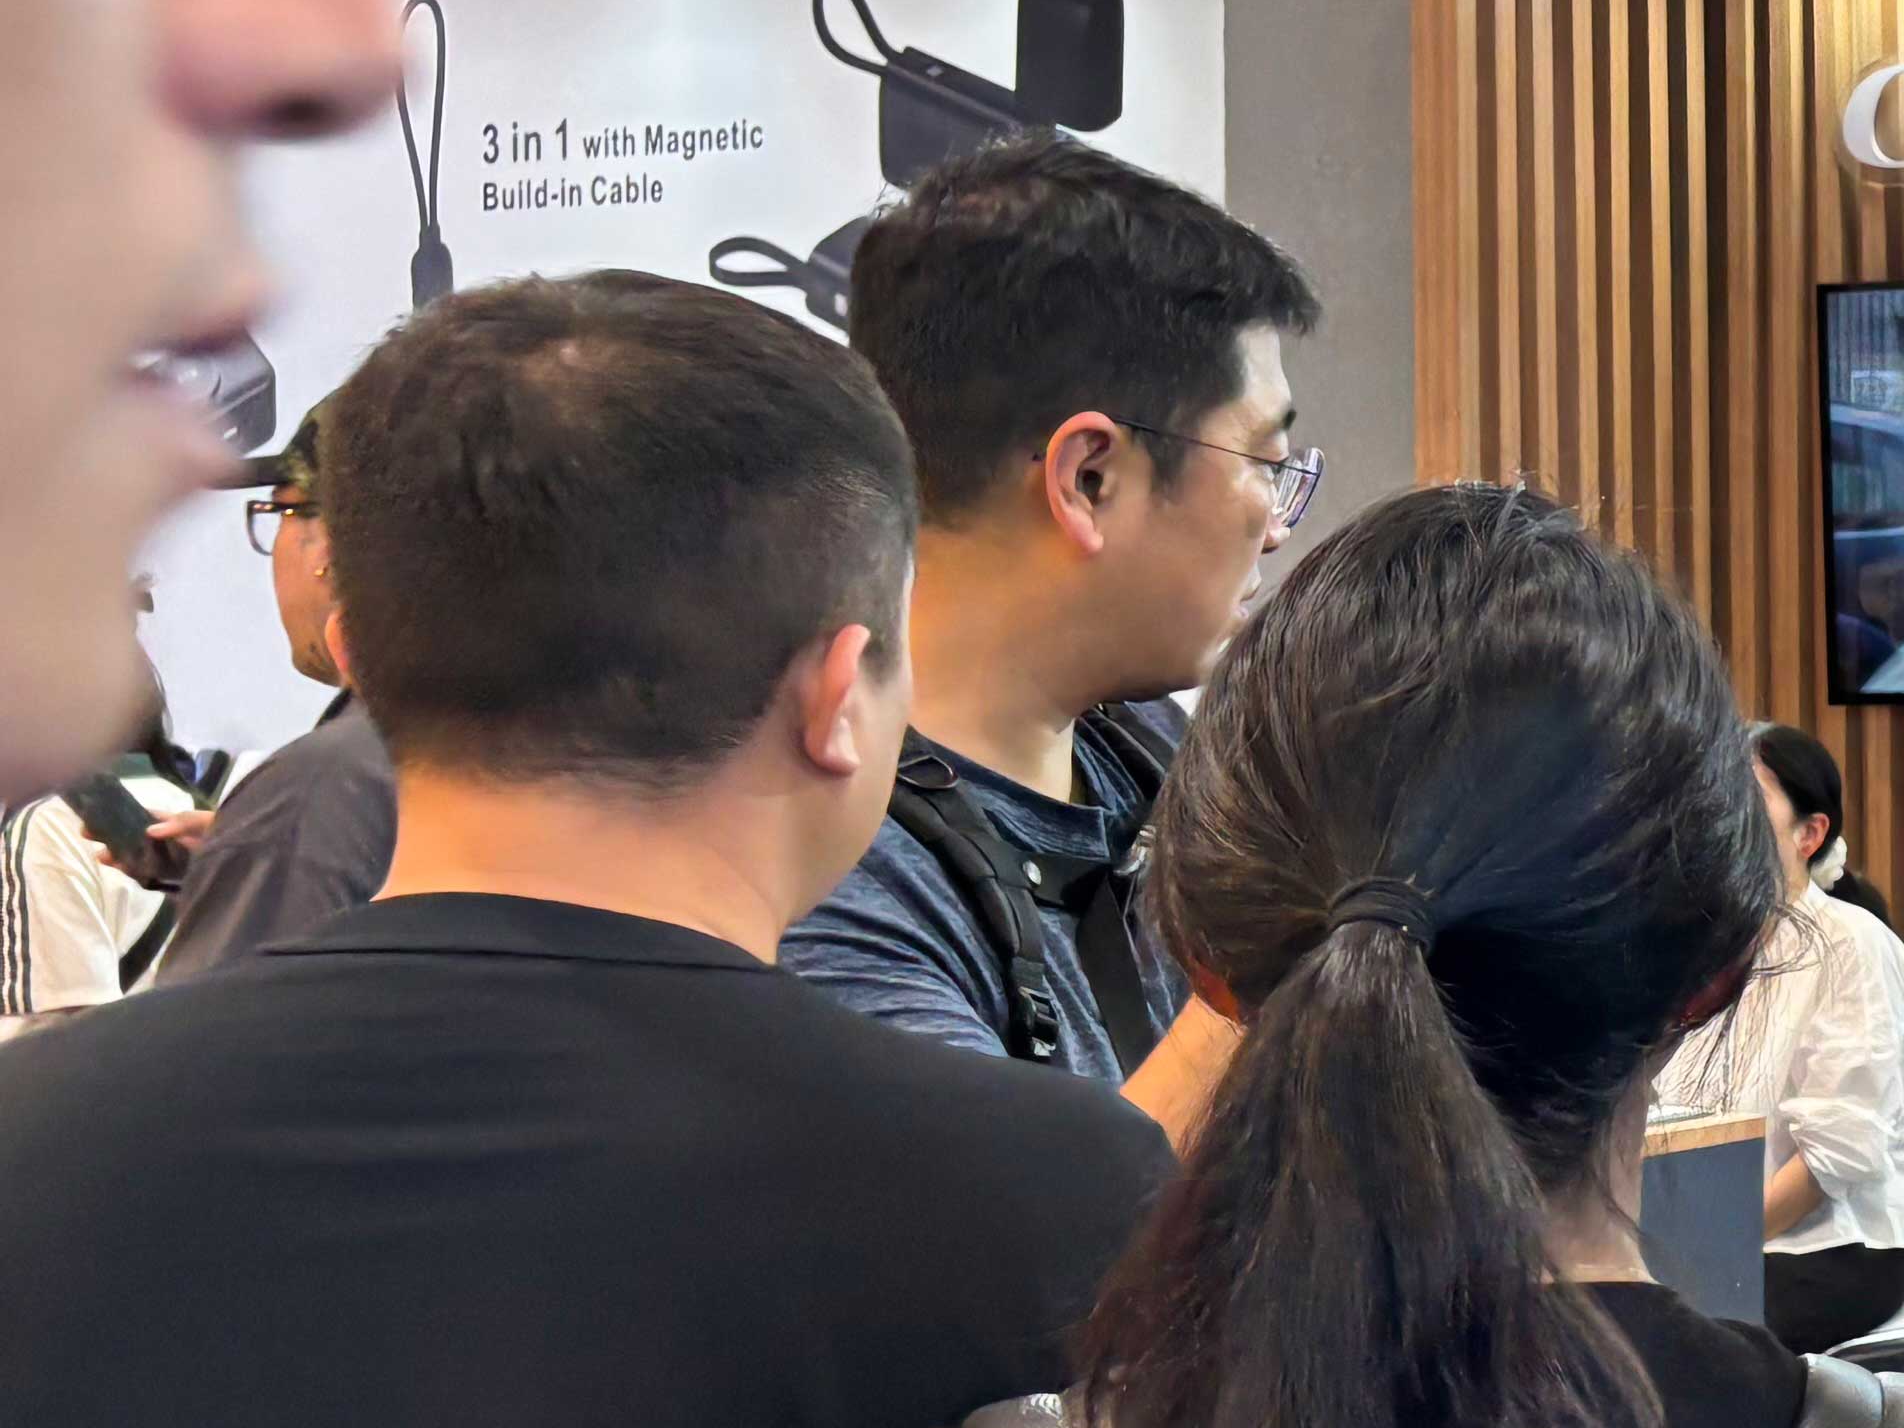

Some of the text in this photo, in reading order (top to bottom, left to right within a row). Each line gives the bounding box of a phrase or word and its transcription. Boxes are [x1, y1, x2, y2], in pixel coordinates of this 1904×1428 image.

[482, 117, 764, 164] 3 in 1 with Magnetic
[482, 171, 664, 212] Build-in Cable
